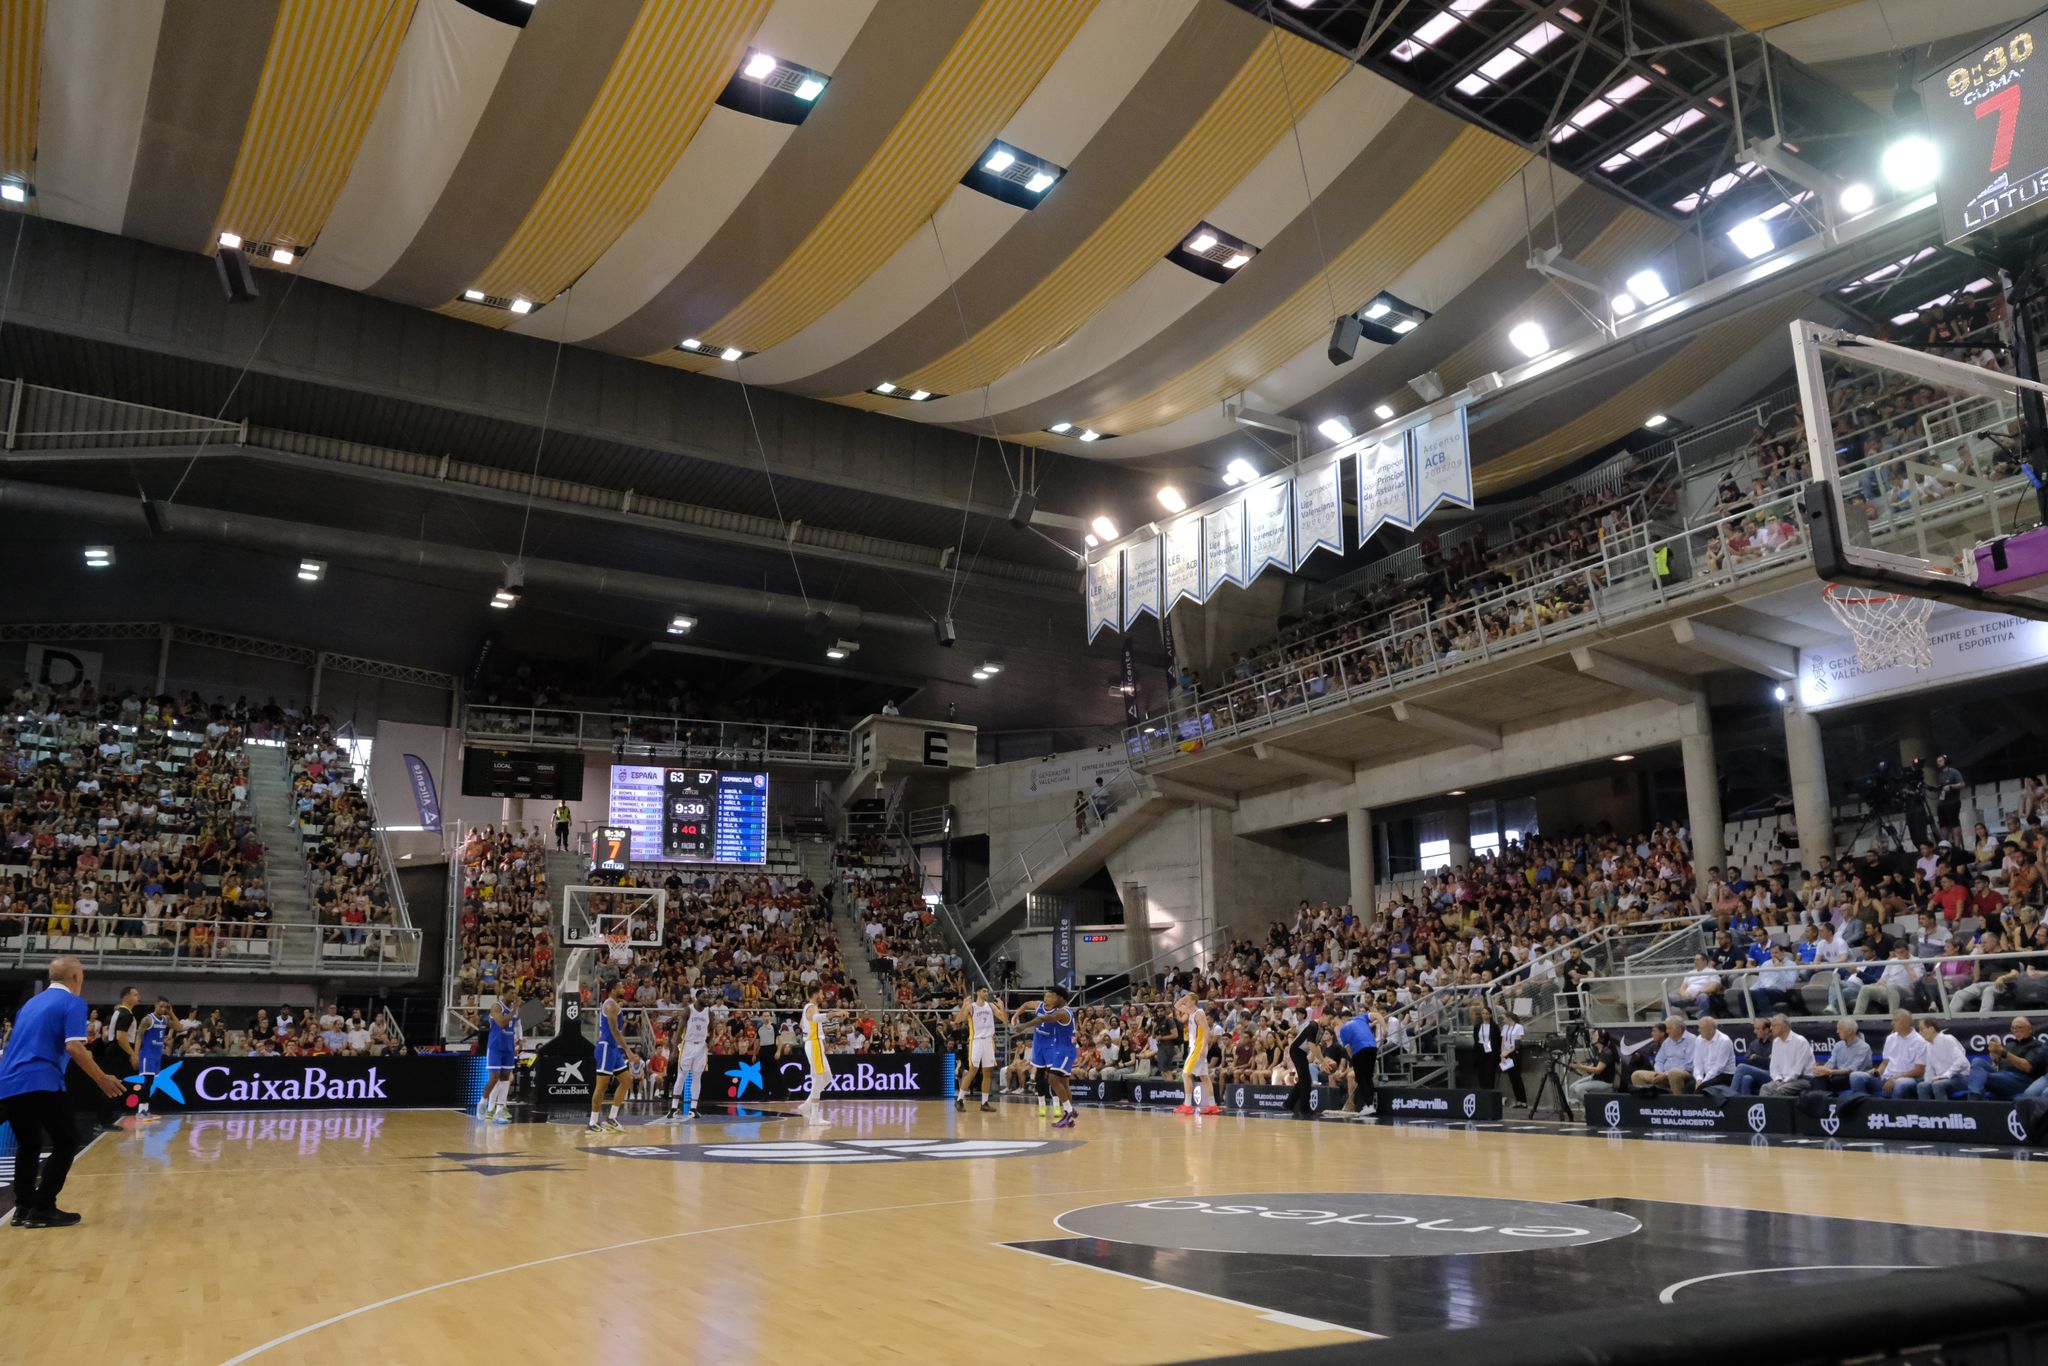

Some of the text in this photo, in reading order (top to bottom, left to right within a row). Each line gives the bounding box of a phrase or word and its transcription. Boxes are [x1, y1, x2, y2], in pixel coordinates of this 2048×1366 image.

[1947, 32, 2033, 97] 9:30
[1974, 84, 2021, 172] 7
[1424, 434, 1460, 453] Ascenso
[1425, 452, 1446, 469] ACB
[1375, 482, 1405, 496] Asturias
[1300, 501, 1313, 510] Liga
[1301, 502, 1335, 519] Valenciana
[1253, 526, 1285, 541] Valenciana
[1168, 554, 1181, 567] LEB
[1186, 559, 1198, 570] ACB
[1091, 585, 1103, 598] LEB
[1964, 627, 1978, 638] DE
[1959, 632, 2015, 651] ESPORTIVA
[40, 648, 84, 690] D
[862, 731, 870, 768] E
[924, 731, 948, 768] E
[631, 771, 657, 780] ESPAÑA
[670, 772, 712, 784] 63 57
[675, 804, 704, 815] 9:30
[604, 830, 626, 838] 9:30
[681, 825, 697, 835] 4Q
[608, 841, 621, 859] 7
[1060, 919, 1069, 968] Alicante
[194, 1066, 388, 1102] CaixaBank
[780, 1061, 921, 1094] CaxaBank
[548, 1086, 589, 1095] CaixaBank
[1392, 1098, 1448, 1110] #LaFamilia
[1640, 1107, 1725, 1118] SELECCIÓN ESPAÑOLA
[1663, 1118, 1715, 1127] BALONCESTO
[1867, 1113, 1976, 1130] #LaFamilia
[1128, 1199, 1590, 1237] endesa
